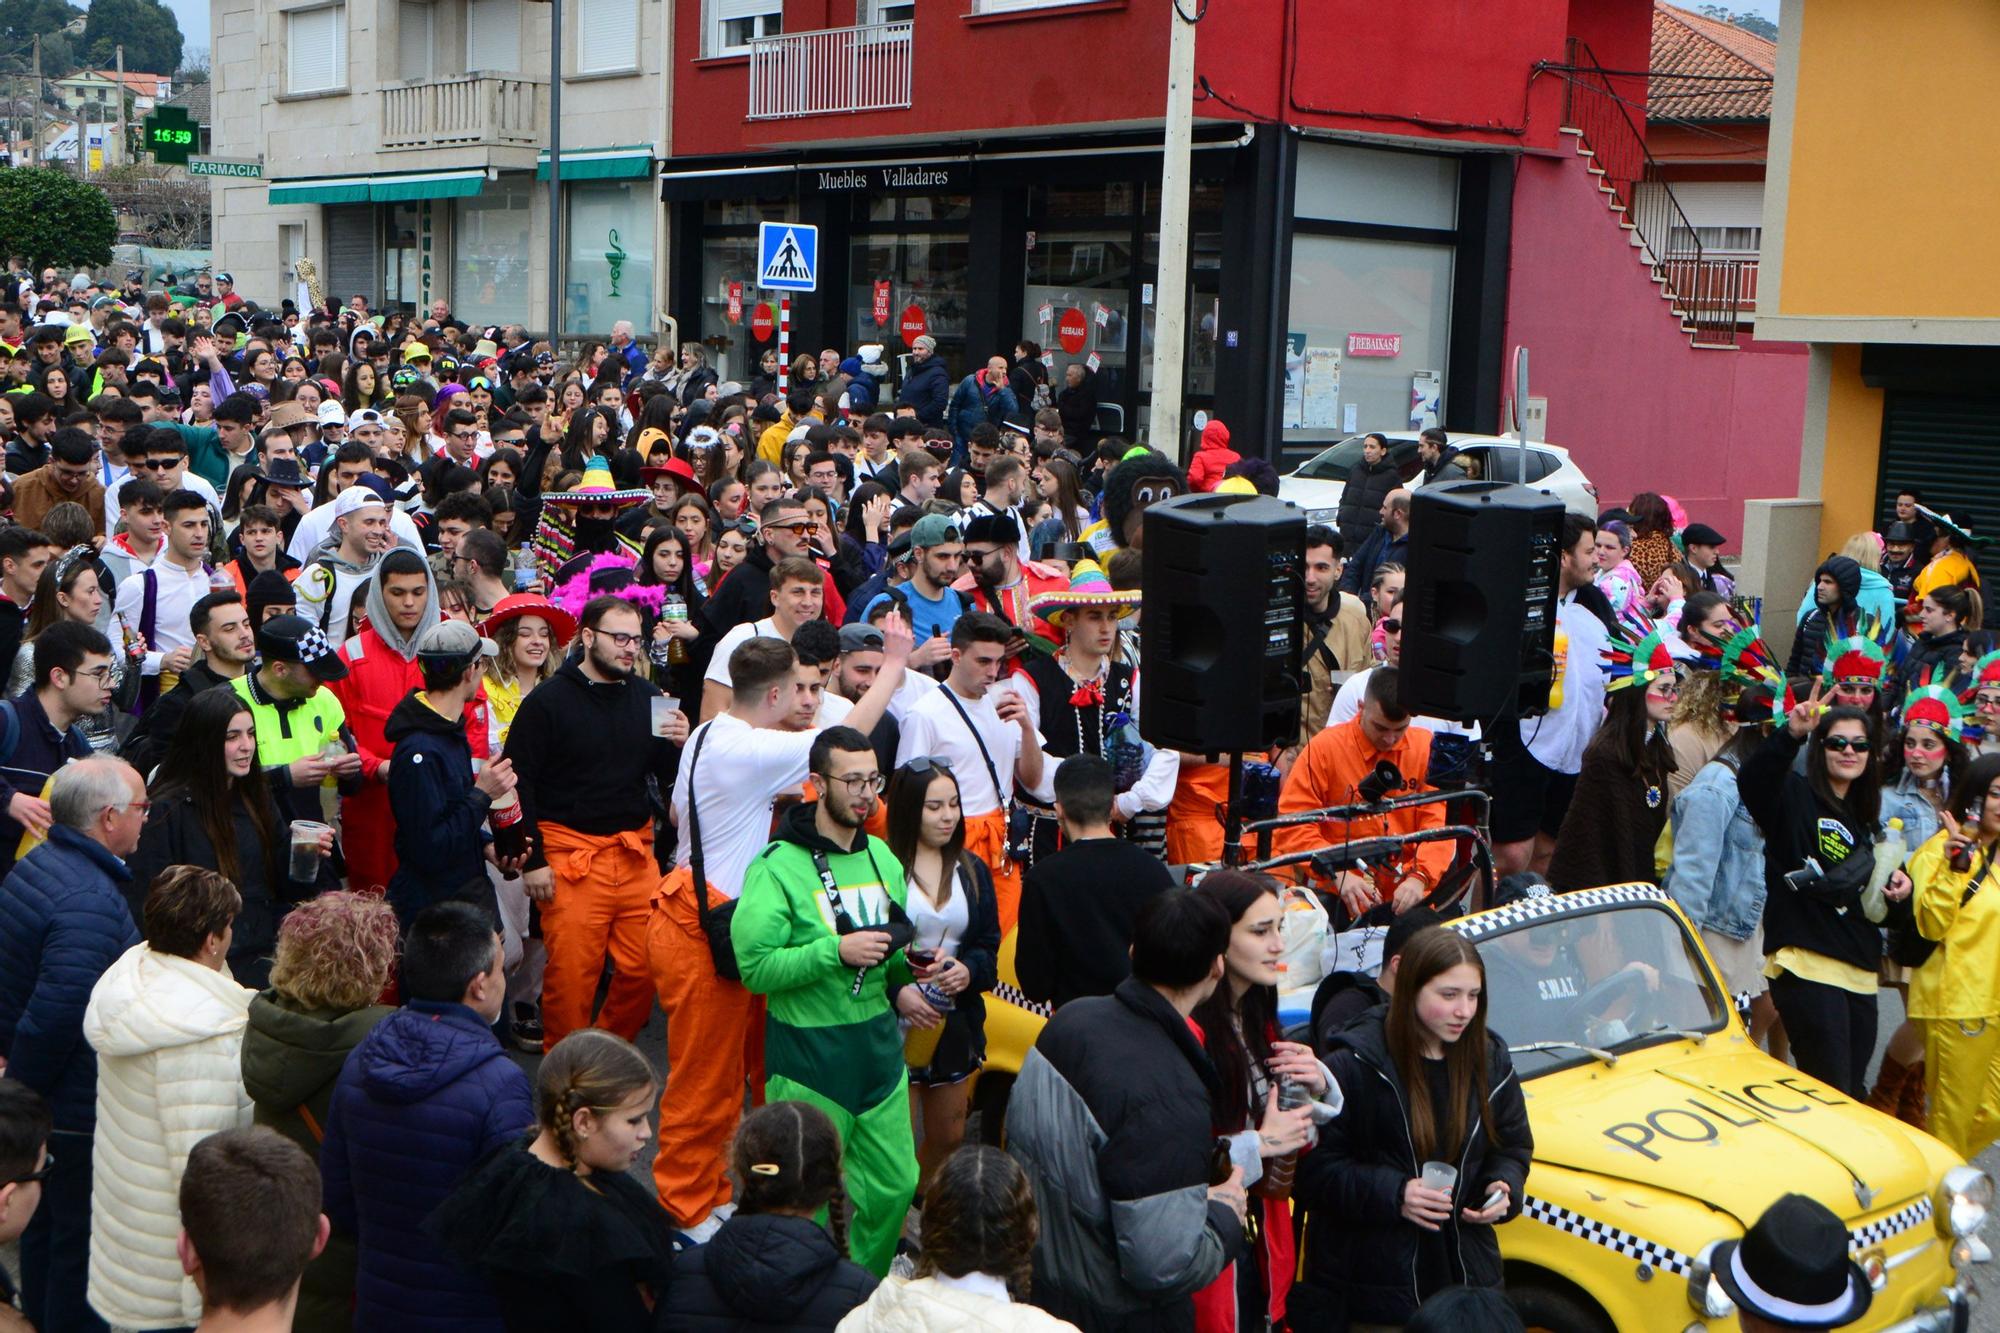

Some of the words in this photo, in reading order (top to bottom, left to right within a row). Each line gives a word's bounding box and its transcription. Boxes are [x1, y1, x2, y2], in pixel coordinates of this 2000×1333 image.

[153, 128, 192, 145] 16:59
[191, 162, 259, 177] FARMACIA
[818, 170, 867, 190] Muebles
[882, 166, 949, 187] Valladares
[903, 322, 924, 331] REBAJAS
[1061, 325, 1085, 337] REBAJAS
[1356, 337, 1394, 351] REBAIXAS
[441, 361, 455, 369] FBI
[820, 870, 839, 901] FILA
